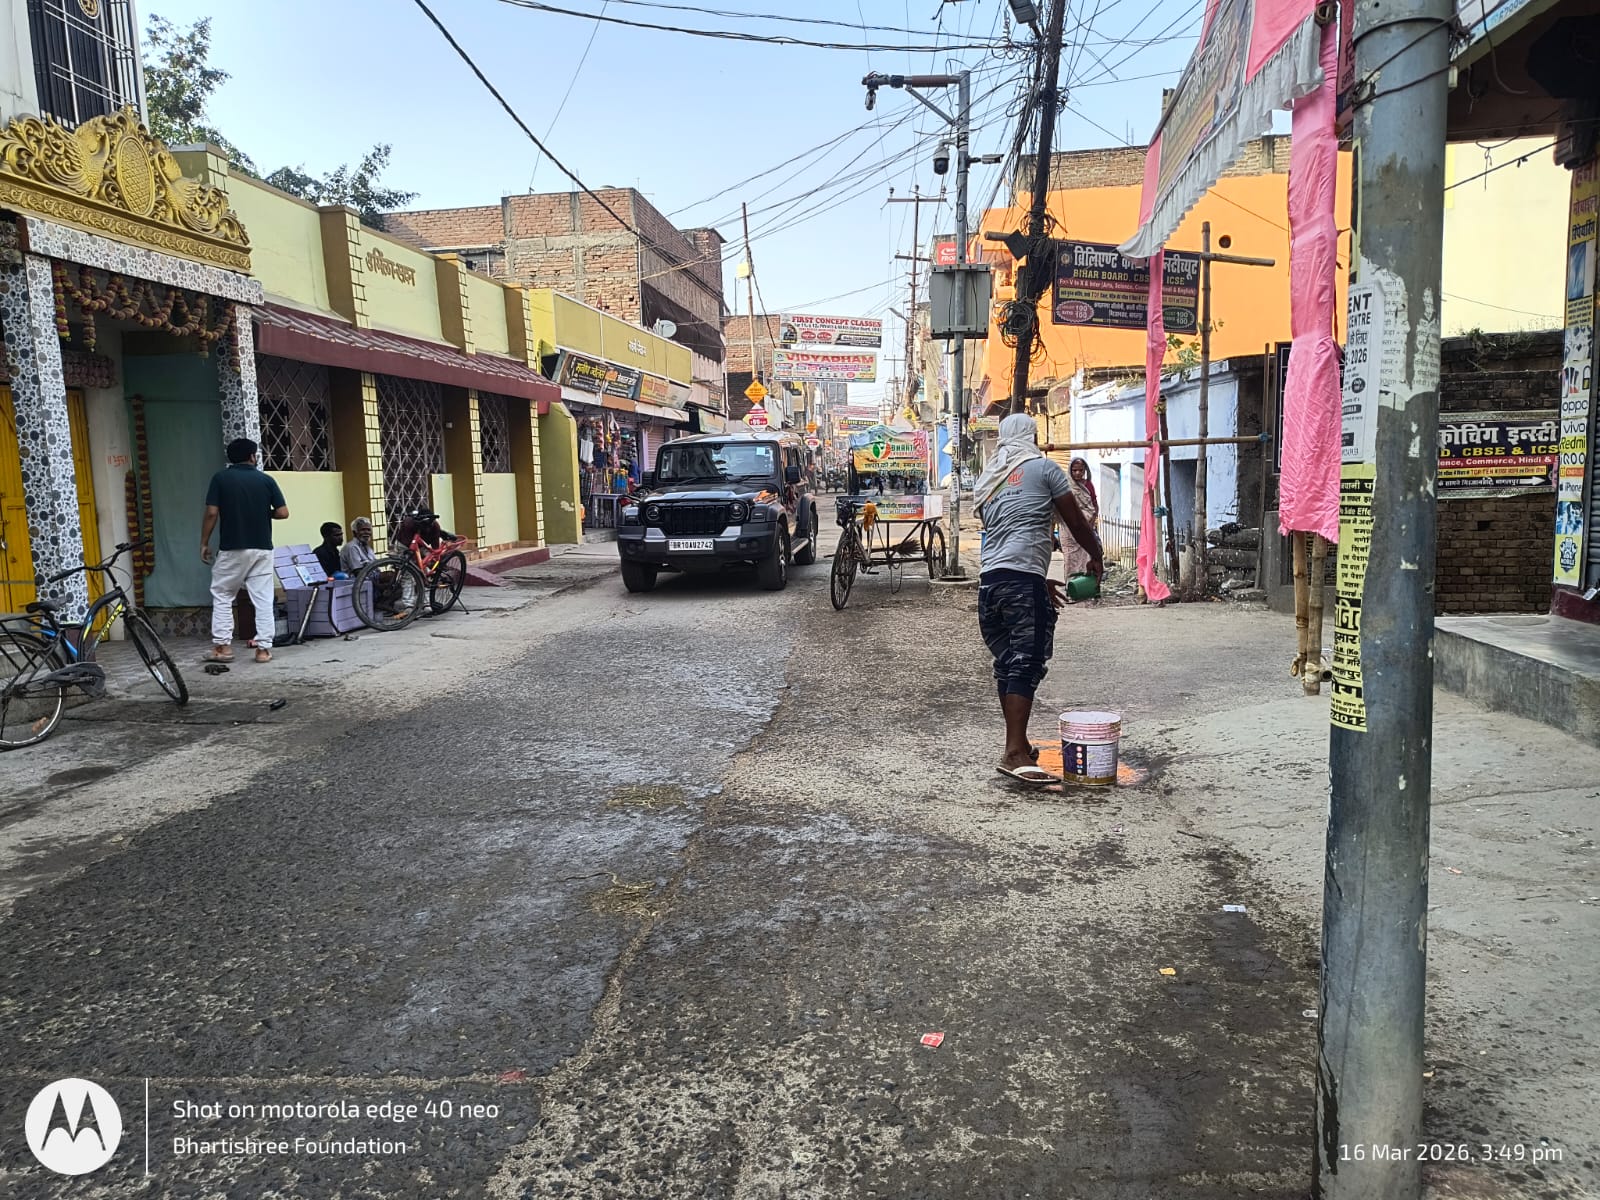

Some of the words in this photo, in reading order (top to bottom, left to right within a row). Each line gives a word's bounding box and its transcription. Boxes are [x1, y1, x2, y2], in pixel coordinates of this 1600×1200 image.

[1073, 269, 1099, 279] BIHAR
[1134, 274, 1150, 282] CBS
[1167, 276, 1185, 285] ICSE
[792, 316, 814, 324] FIRST
[815, 317, 849, 326] CONCEPT
[850, 319, 882, 328] CLASSES
[1349, 312, 1371, 328] CENTRE
[786, 353, 874, 363] VIDYADHAM
[1562, 400, 1588, 414] oppo
[1563, 421, 1586, 433] vivo
[1560, 436, 1586, 450] Redmi
[1462, 447, 1506, 456] CBSE
[1511, 447, 1525, 455] &
[1531, 445, 1560, 454] ICS
[1438, 459, 1463, 467] ience,
[1564, 481, 1582, 492] iPhone
